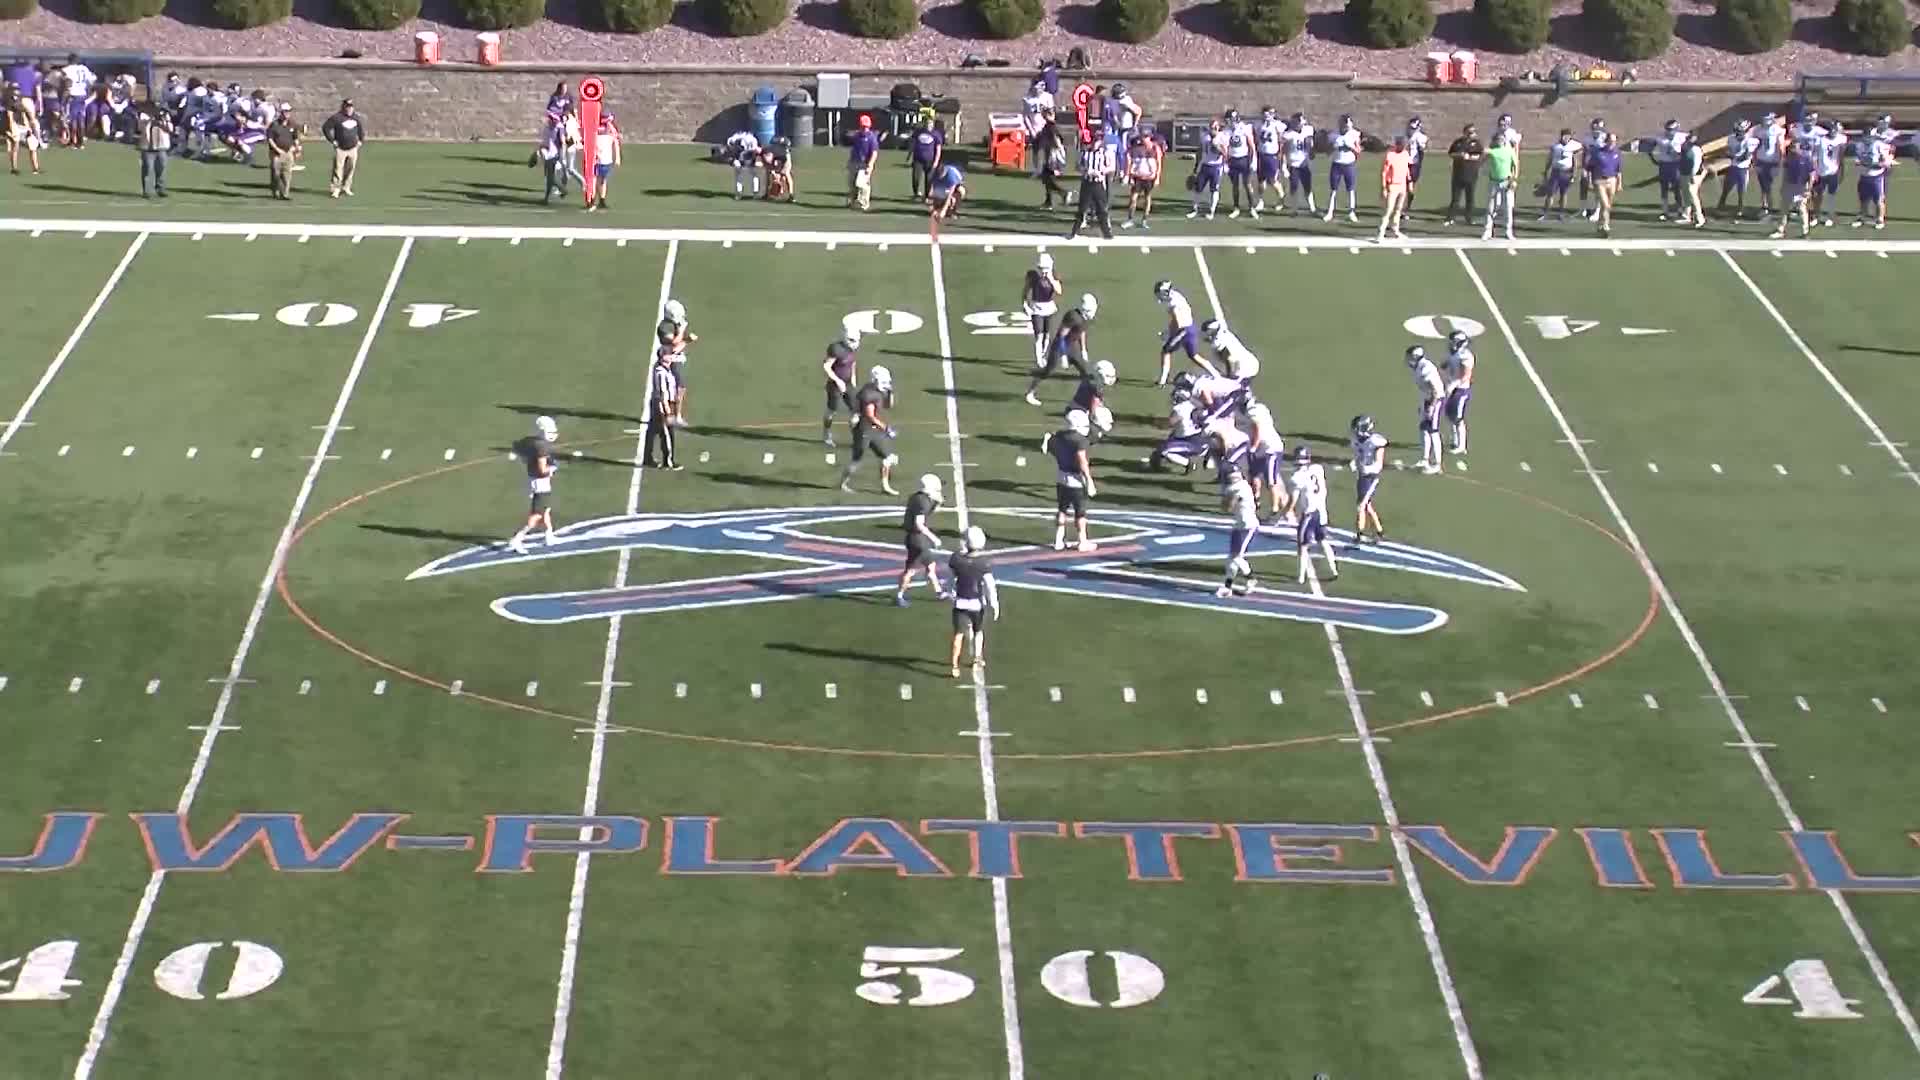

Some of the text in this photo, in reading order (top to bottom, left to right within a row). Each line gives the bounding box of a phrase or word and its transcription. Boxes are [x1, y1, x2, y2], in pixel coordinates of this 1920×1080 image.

[0, 812, 1920, 893] UW-PLATTEVILL
[0, 940, 284, 1000] 40
[855, 946, 1165, 1008] 50
[1742, 959, 1865, 1019] 4
